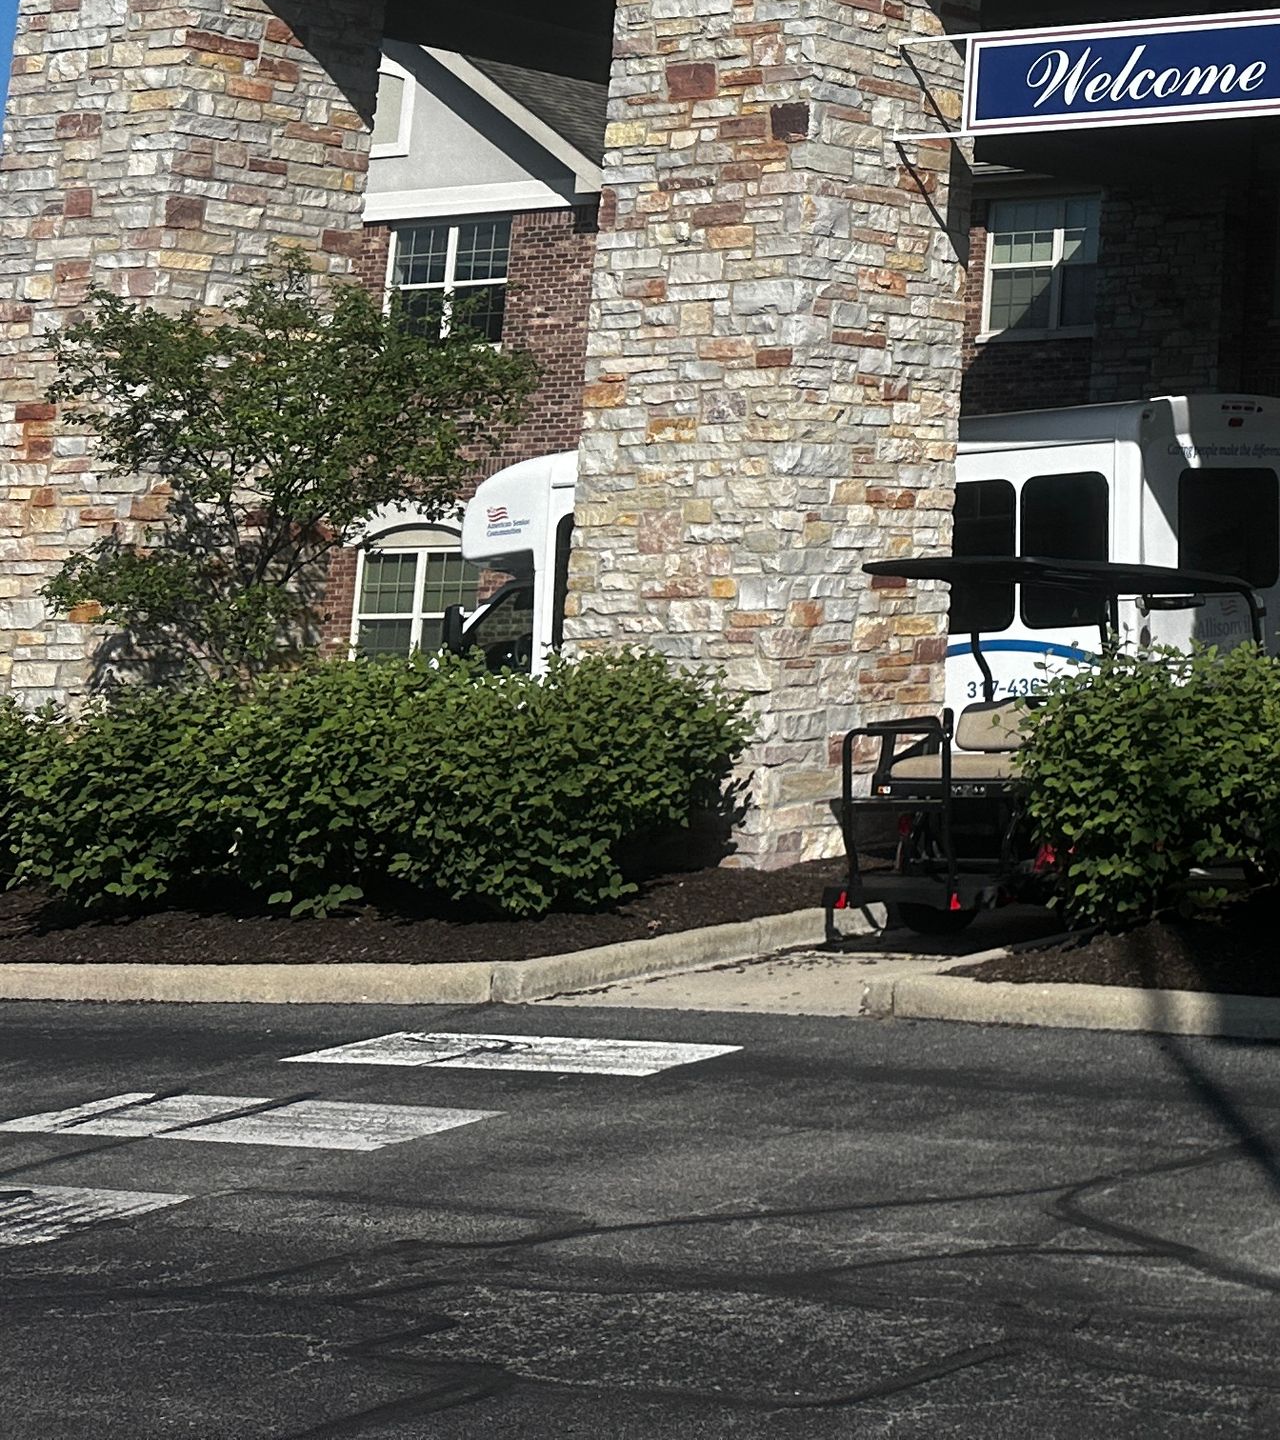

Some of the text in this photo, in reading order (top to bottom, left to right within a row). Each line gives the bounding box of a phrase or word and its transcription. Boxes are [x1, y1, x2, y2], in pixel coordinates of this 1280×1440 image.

[1026, 44, 1267, 108] Welcome
[1194, 443, 1218, 459] people
[1220, 443, 1239, 456] make
[1240, 443, 1251, 456] the
